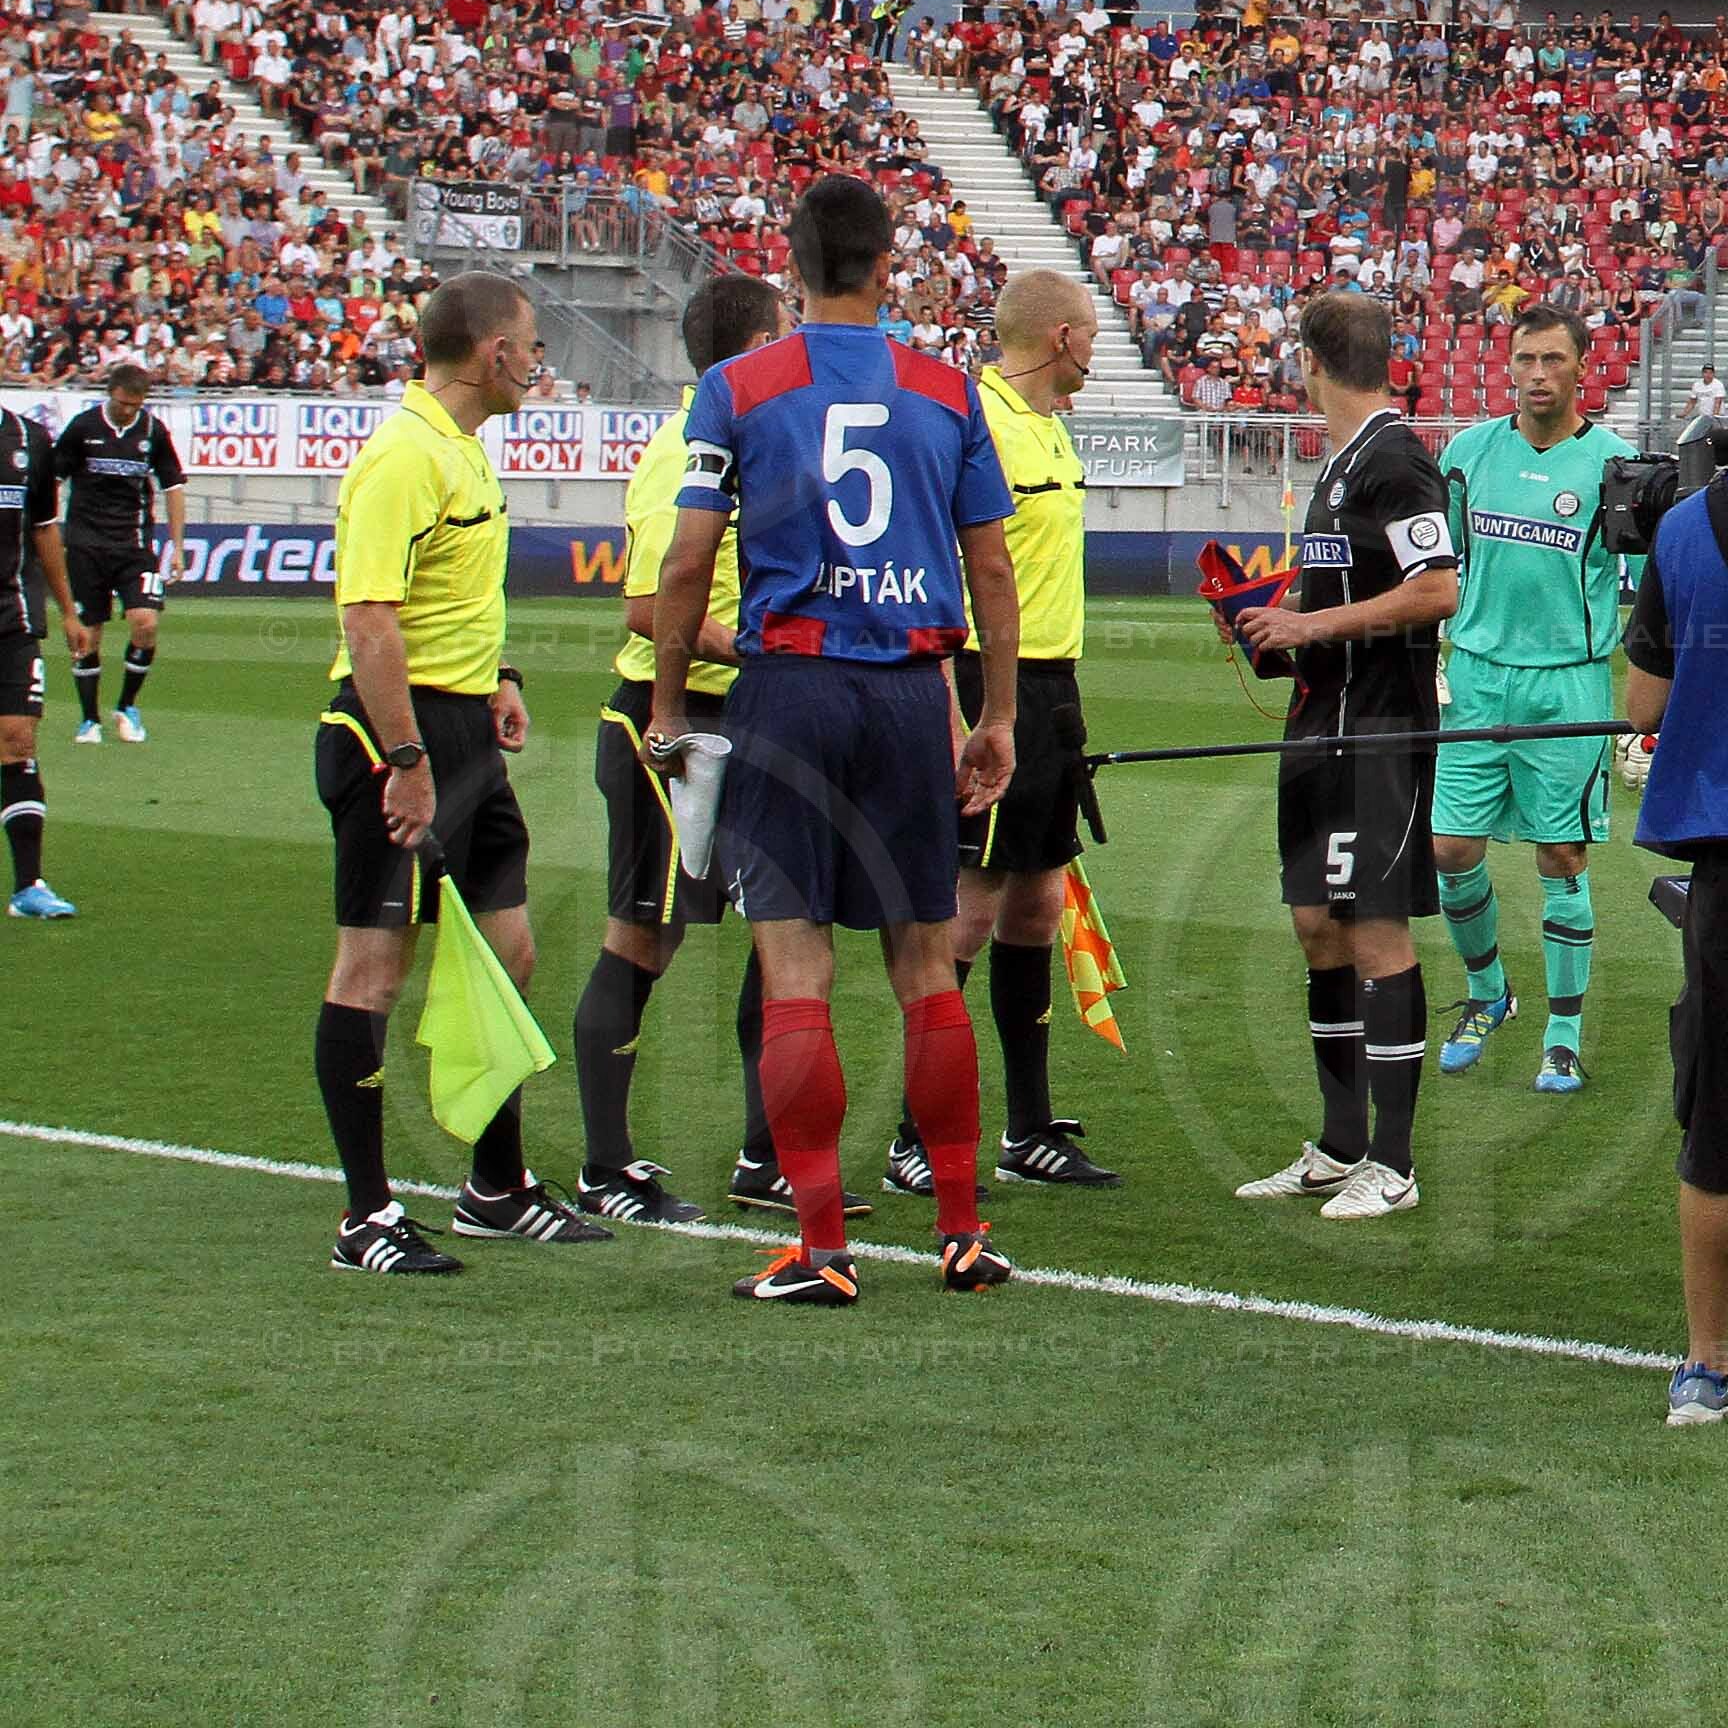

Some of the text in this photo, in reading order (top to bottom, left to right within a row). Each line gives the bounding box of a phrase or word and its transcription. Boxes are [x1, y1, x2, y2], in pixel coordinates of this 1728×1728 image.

[440, 189, 519, 214] Young Boys
[192, 405, 277, 435] LIQUI
[300, 406, 382, 437] LIQUI
[504, 411, 583, 441] LIQUI
[191, 437, 278, 466] MOLY
[503, 441, 583, 471] MOLY
[601, 441, 644, 471] MO
[1075, 434, 1159, 453] TPARK
[822, 403, 893, 548] 5
[1085, 459, 1159, 478] NFURT
[1474, 514, 1577, 549] PUNTIGAMER
[1326, 831, 1358, 886] 5
